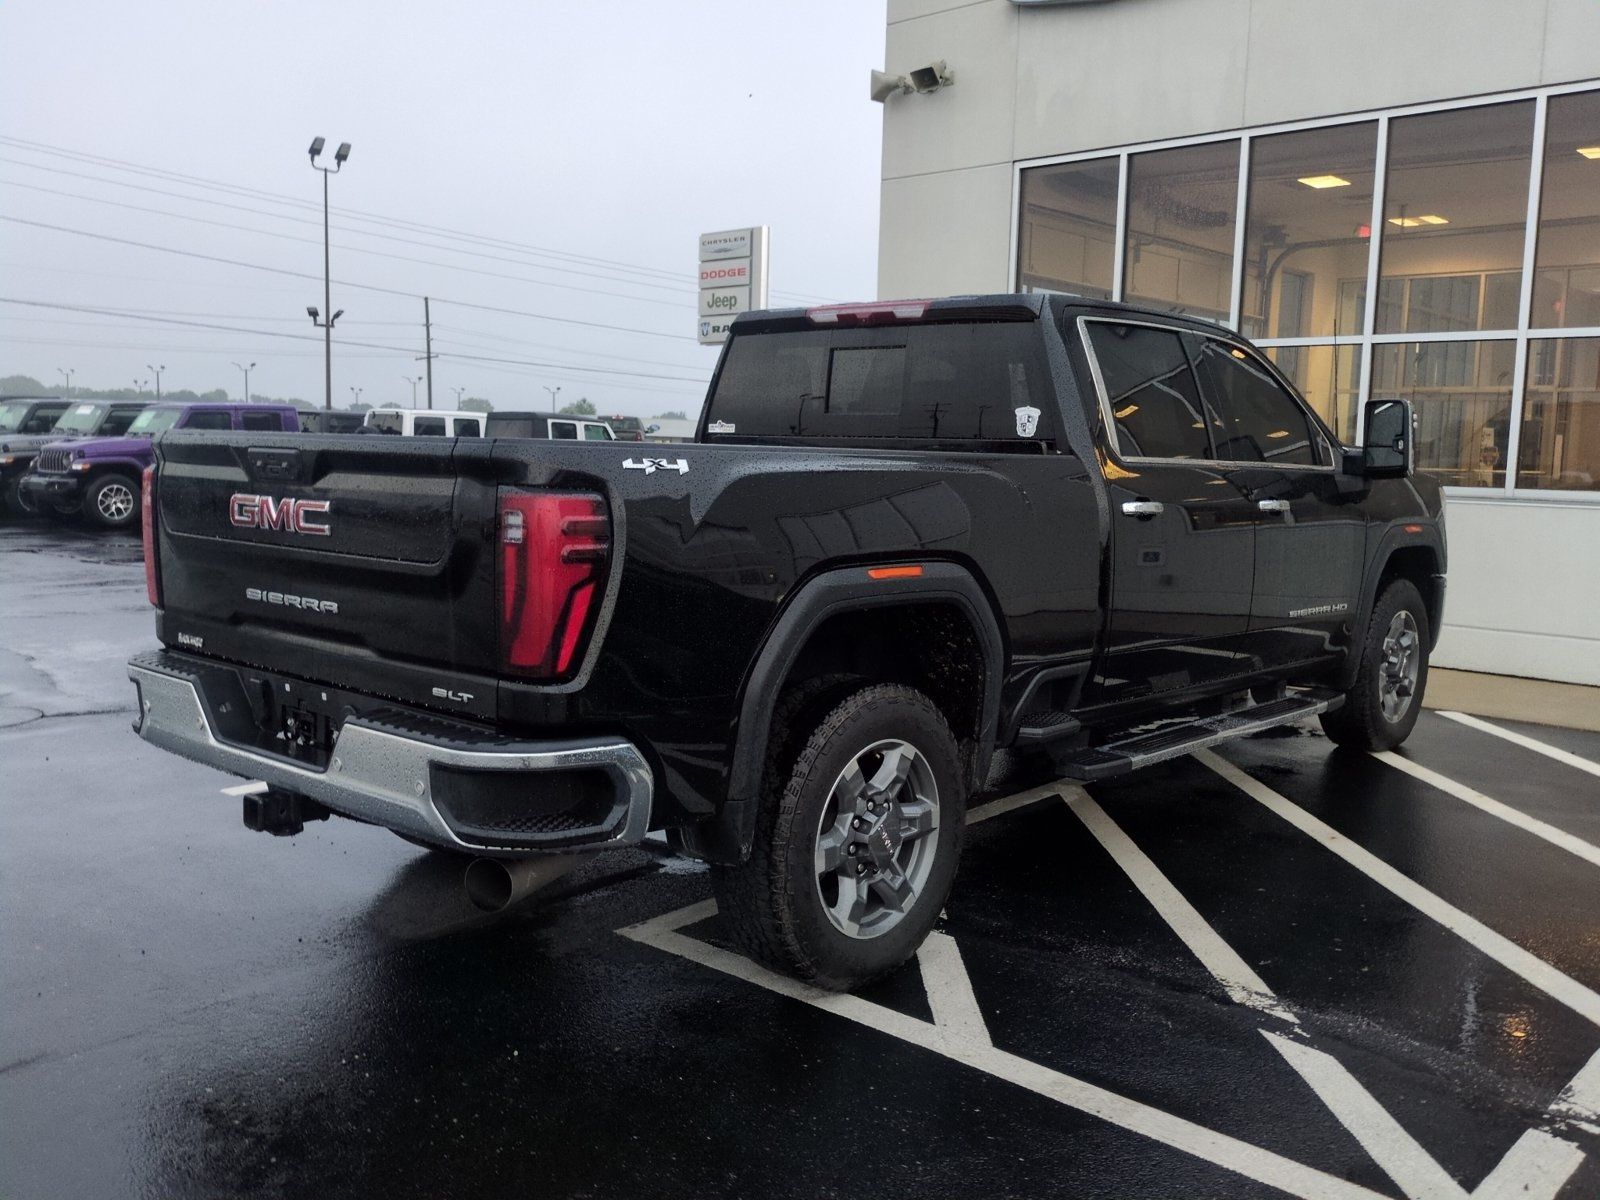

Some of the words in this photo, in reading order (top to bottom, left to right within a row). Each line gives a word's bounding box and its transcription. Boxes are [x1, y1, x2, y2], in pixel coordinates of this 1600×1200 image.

[702, 236, 745, 246] CHRYSLER
[701, 267, 747, 280] DODGE
[707, 293, 737, 310] Jeep
[712, 325, 731, 333] RA
[229, 493, 331, 536] GMC
[246, 587, 339, 614] SIERRA
[1289, 605, 1331, 618] SIERRA
[1332, 603, 1347, 611] HD
[432, 687, 474, 704] SLT
